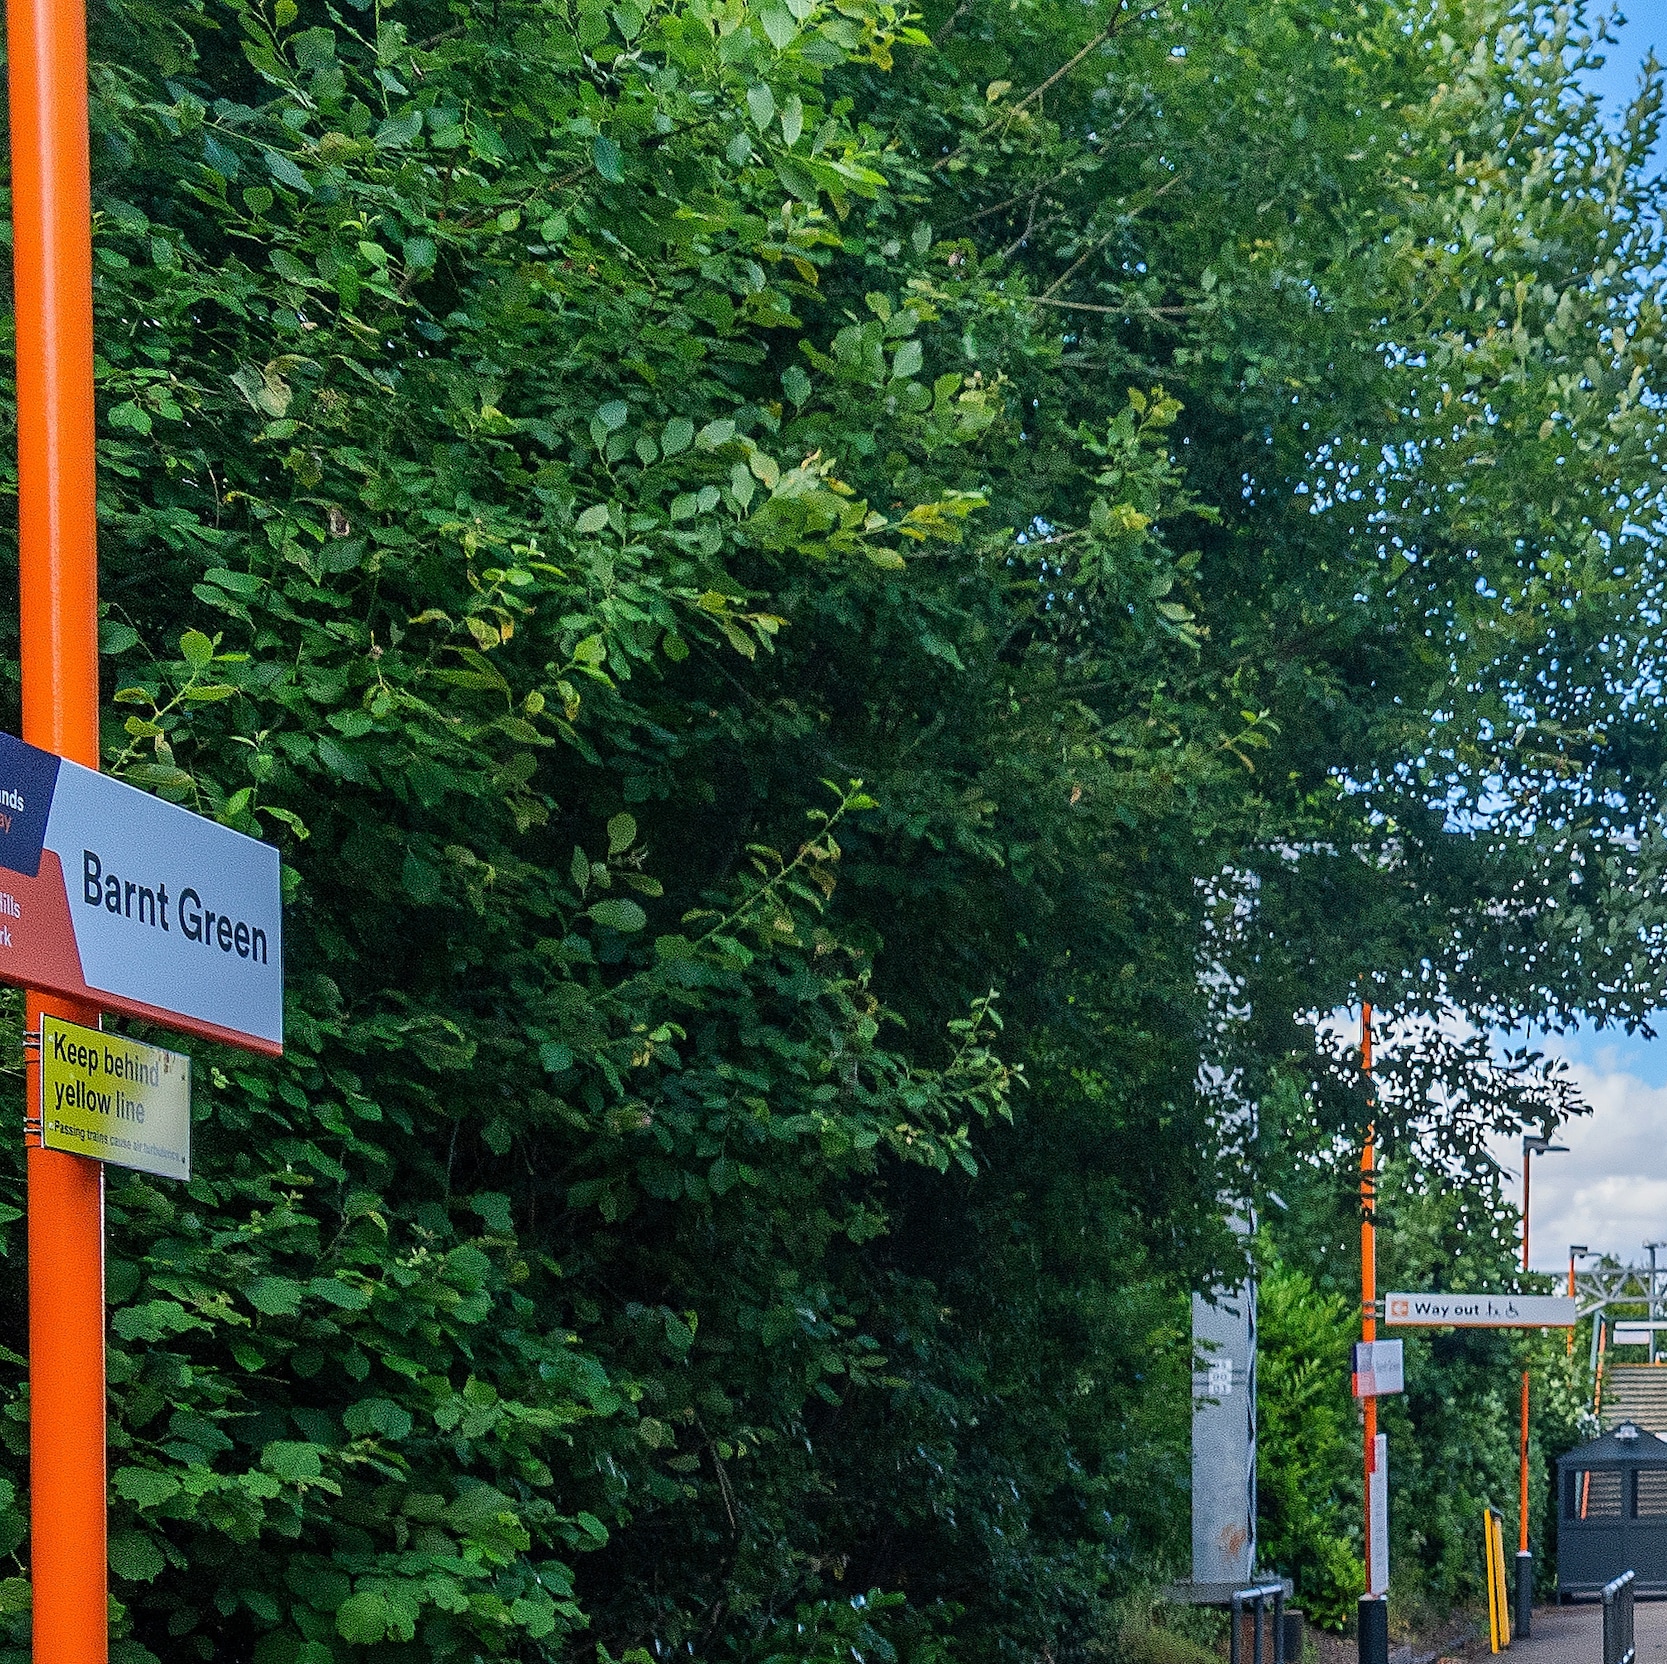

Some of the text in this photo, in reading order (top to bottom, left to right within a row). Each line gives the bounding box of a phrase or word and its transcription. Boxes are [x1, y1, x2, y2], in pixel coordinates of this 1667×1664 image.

[0, 789, 24, 811] nds
[83, 849, 267, 965] Barnt Green
[54, 1031, 159, 1087] Keep behind
[55, 1080, 145, 1124] yellow line
[54, 1119, 85, 1142] Passing
[87, 1128, 109, 1145] trains
[1415, 1302, 1479, 1317] Way out
